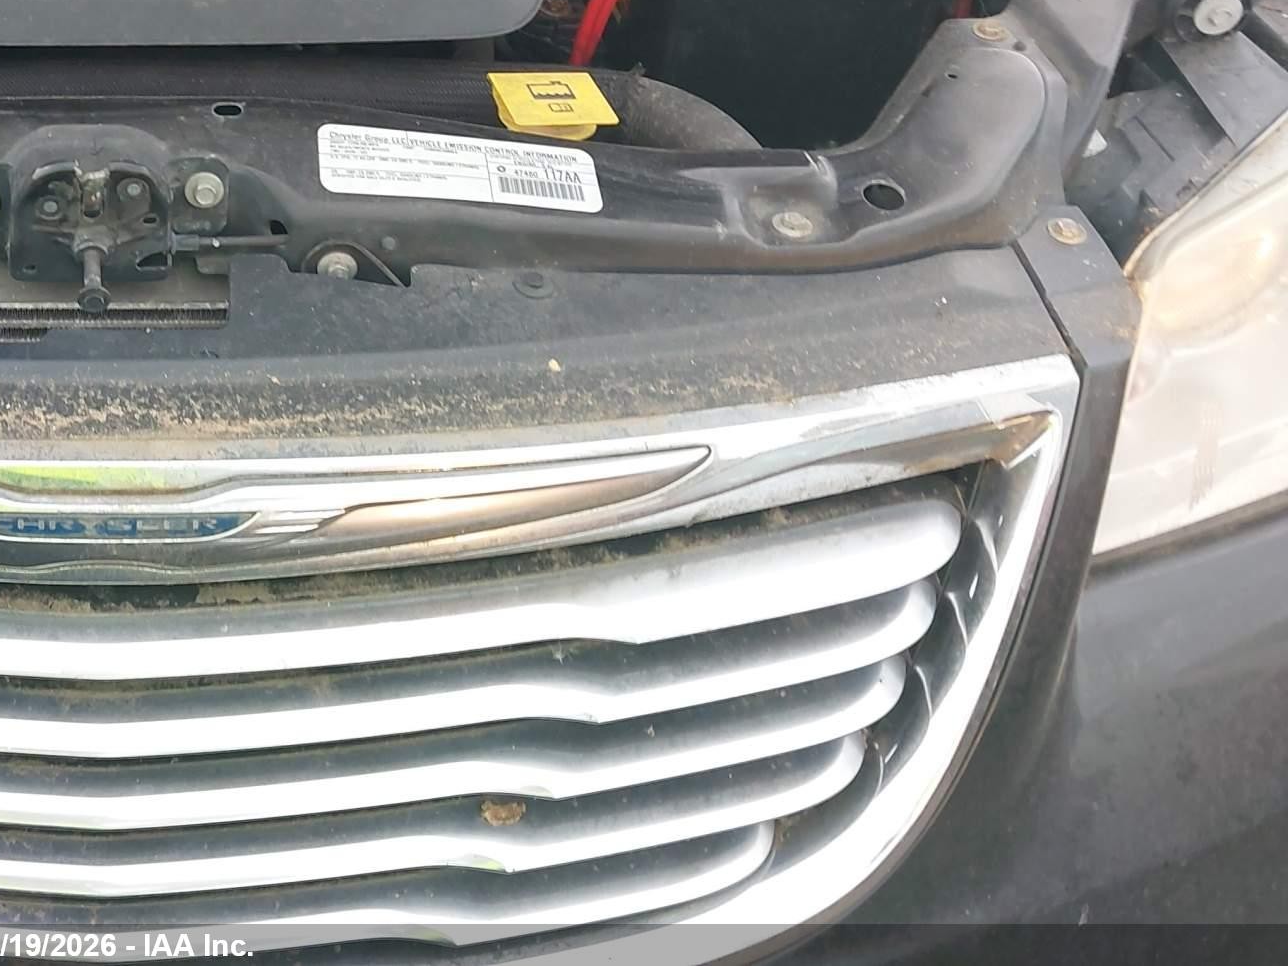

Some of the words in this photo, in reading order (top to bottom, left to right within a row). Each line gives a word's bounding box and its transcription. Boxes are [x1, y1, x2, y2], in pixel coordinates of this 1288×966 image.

[444, 141, 482, 153] EMISSION
[485, 146, 519, 156] CONTROL
[523, 150, 577, 163] INFORMATION
